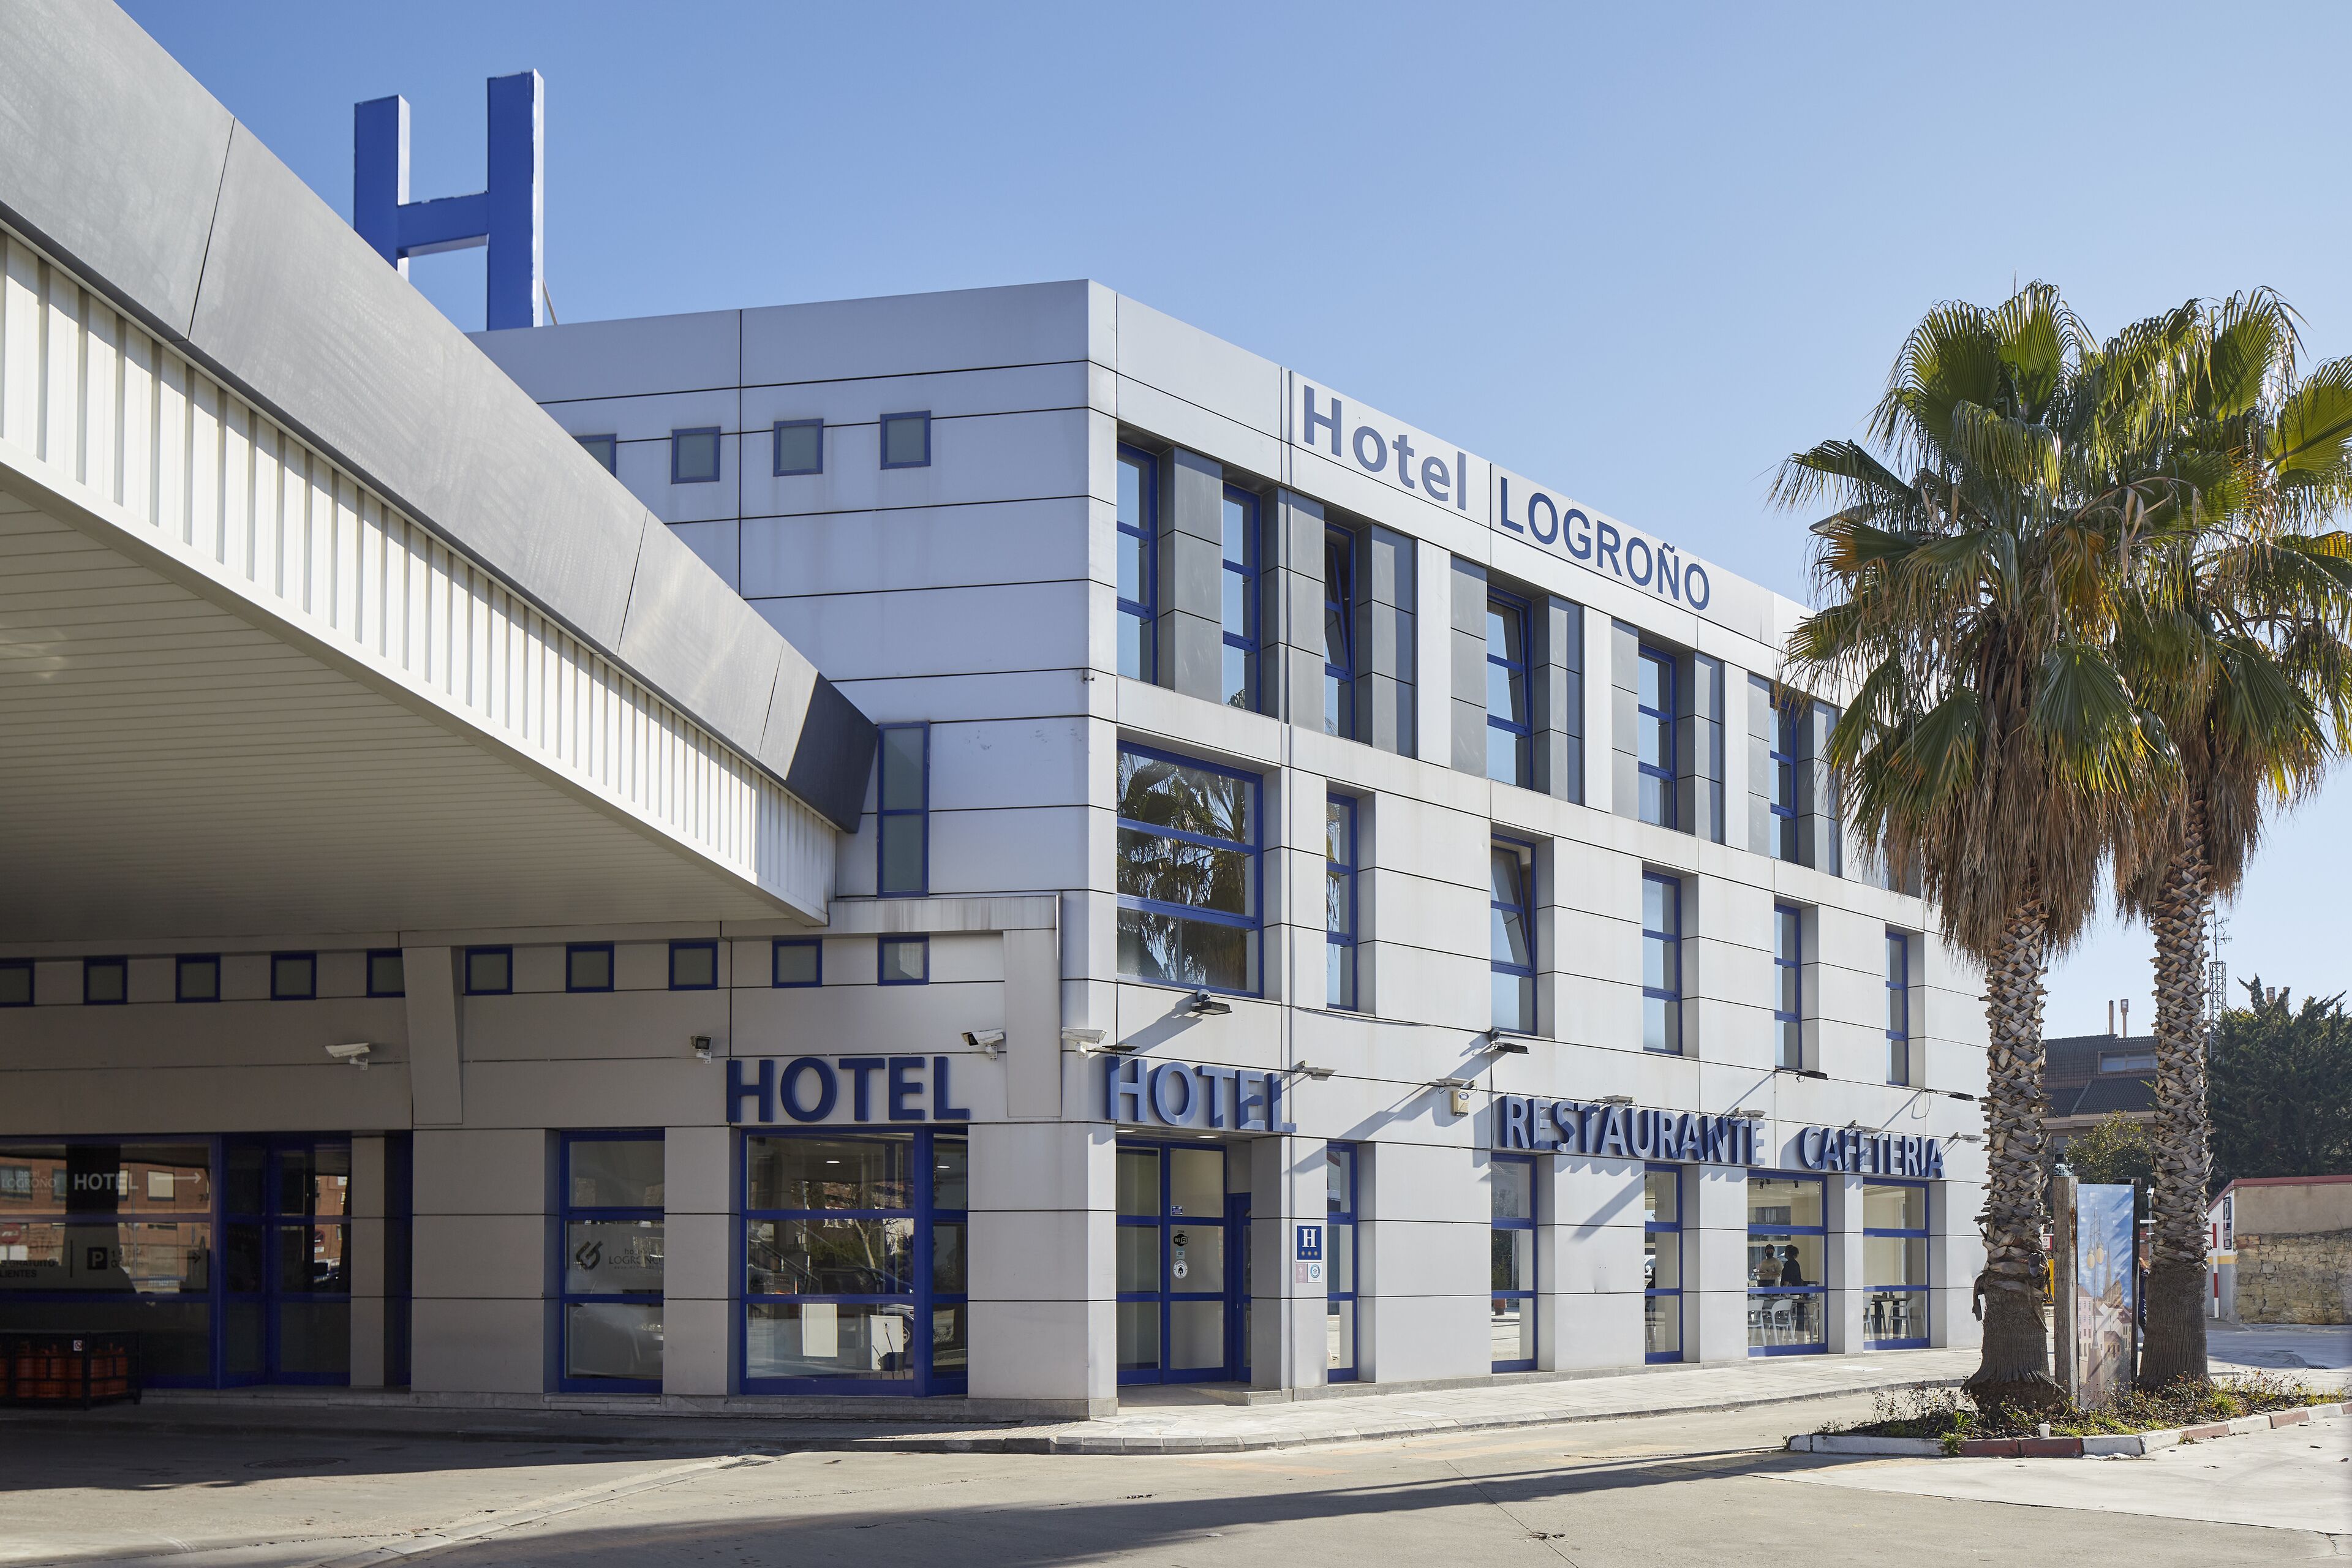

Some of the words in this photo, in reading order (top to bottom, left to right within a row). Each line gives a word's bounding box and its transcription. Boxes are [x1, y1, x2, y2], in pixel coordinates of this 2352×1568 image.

[354, 68, 544, 331] H
[1303, 384, 1467, 511] Hotel
[1500, 476, 1710, 611] LOGROÑO
[726, 1057, 970, 1123] HOTEL
[1105, 1056, 1297, 1133] HOTEL
[1501, 1095, 1766, 1166] RESTAURANTE
[1798, 1125, 1946, 1178] CAFETERIA
[2, 1176, 56, 1189] LOGROÑO
[74, 1173, 139, 1190] HOTEL
[92, 1251, 104, 1267] P
[1302, 1229, 1317, 1248] H
